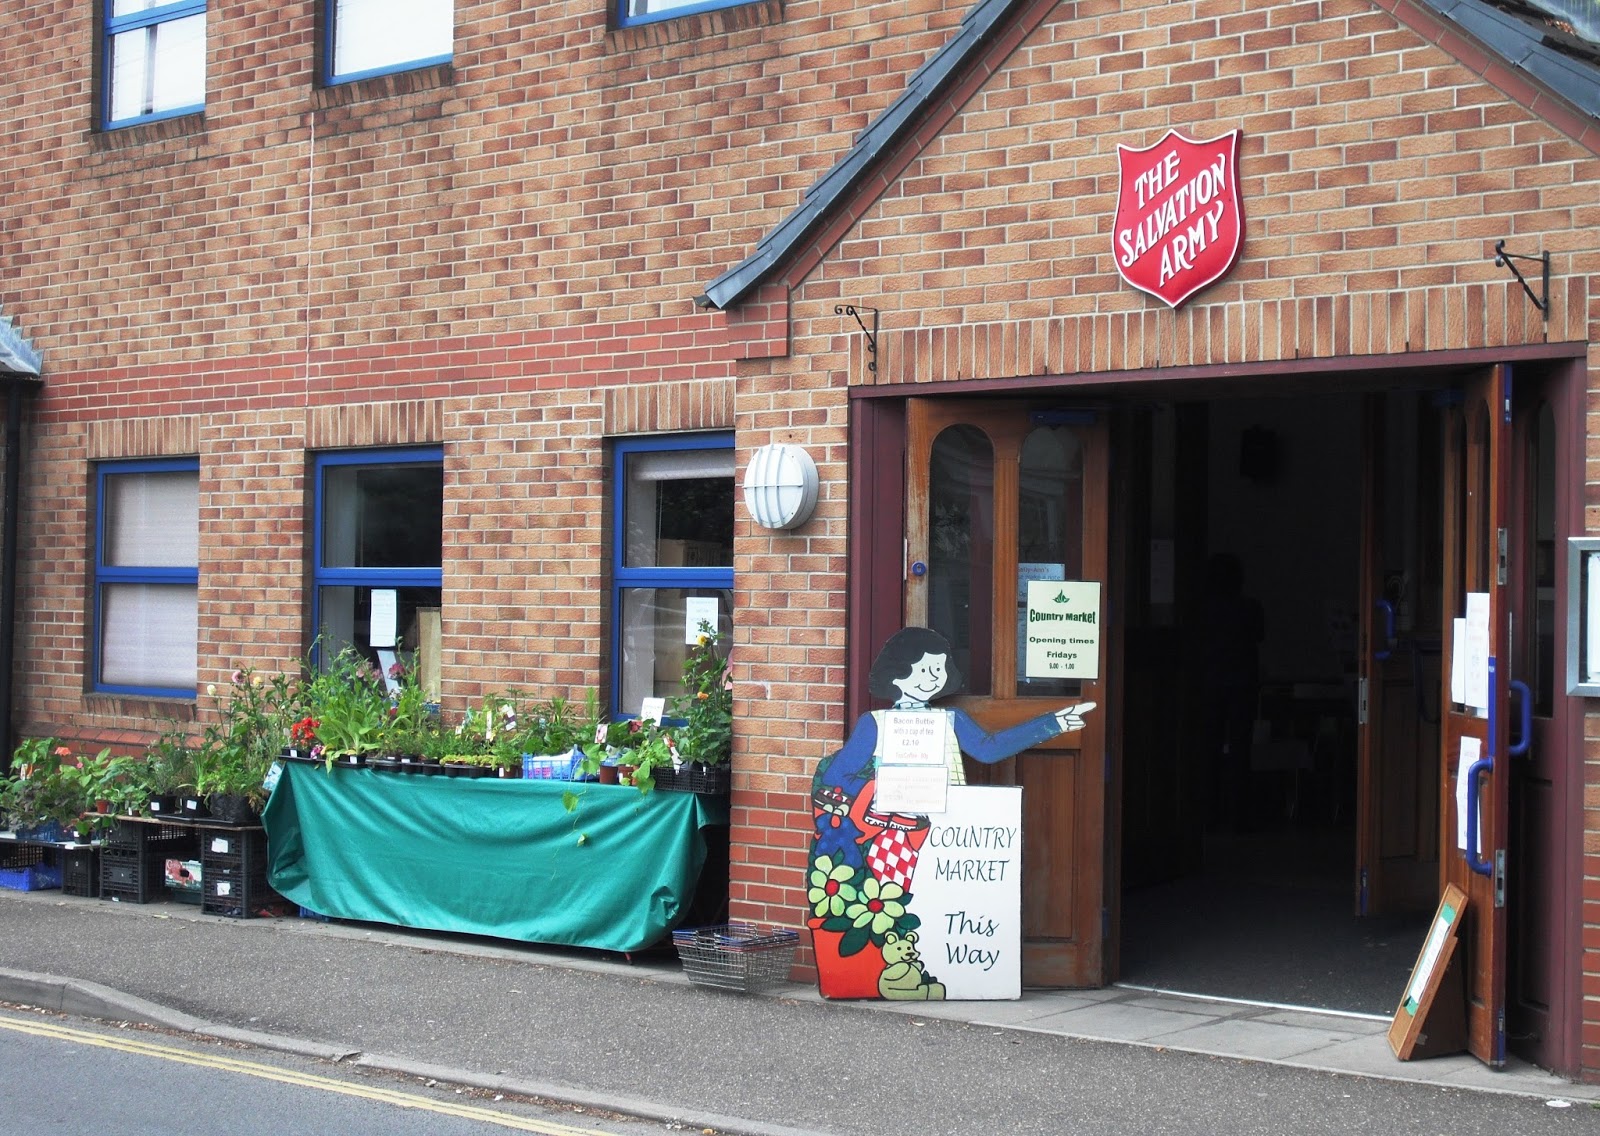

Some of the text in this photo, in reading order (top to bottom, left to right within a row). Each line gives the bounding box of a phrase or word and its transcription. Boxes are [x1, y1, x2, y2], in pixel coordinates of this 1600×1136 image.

[1134, 149, 1181, 210] THE
[1119, 153, 1226, 268] SALVATION
[1159, 200, 1224, 288] ARMY
[1029, 608, 1096, 625] Country Market
[1029, 636, 1095, 645] Opening times
[1046, 651, 1078, 660] Fridays
[893, 717, 935, 725] Bacon Buttie
[925, 728, 934, 736] tea
[929, 825, 1017, 850] COUNTRY
[935, 857, 1010, 882] MARKET
[945, 911, 1000, 937] This
[945, 942, 1000, 972] Way
